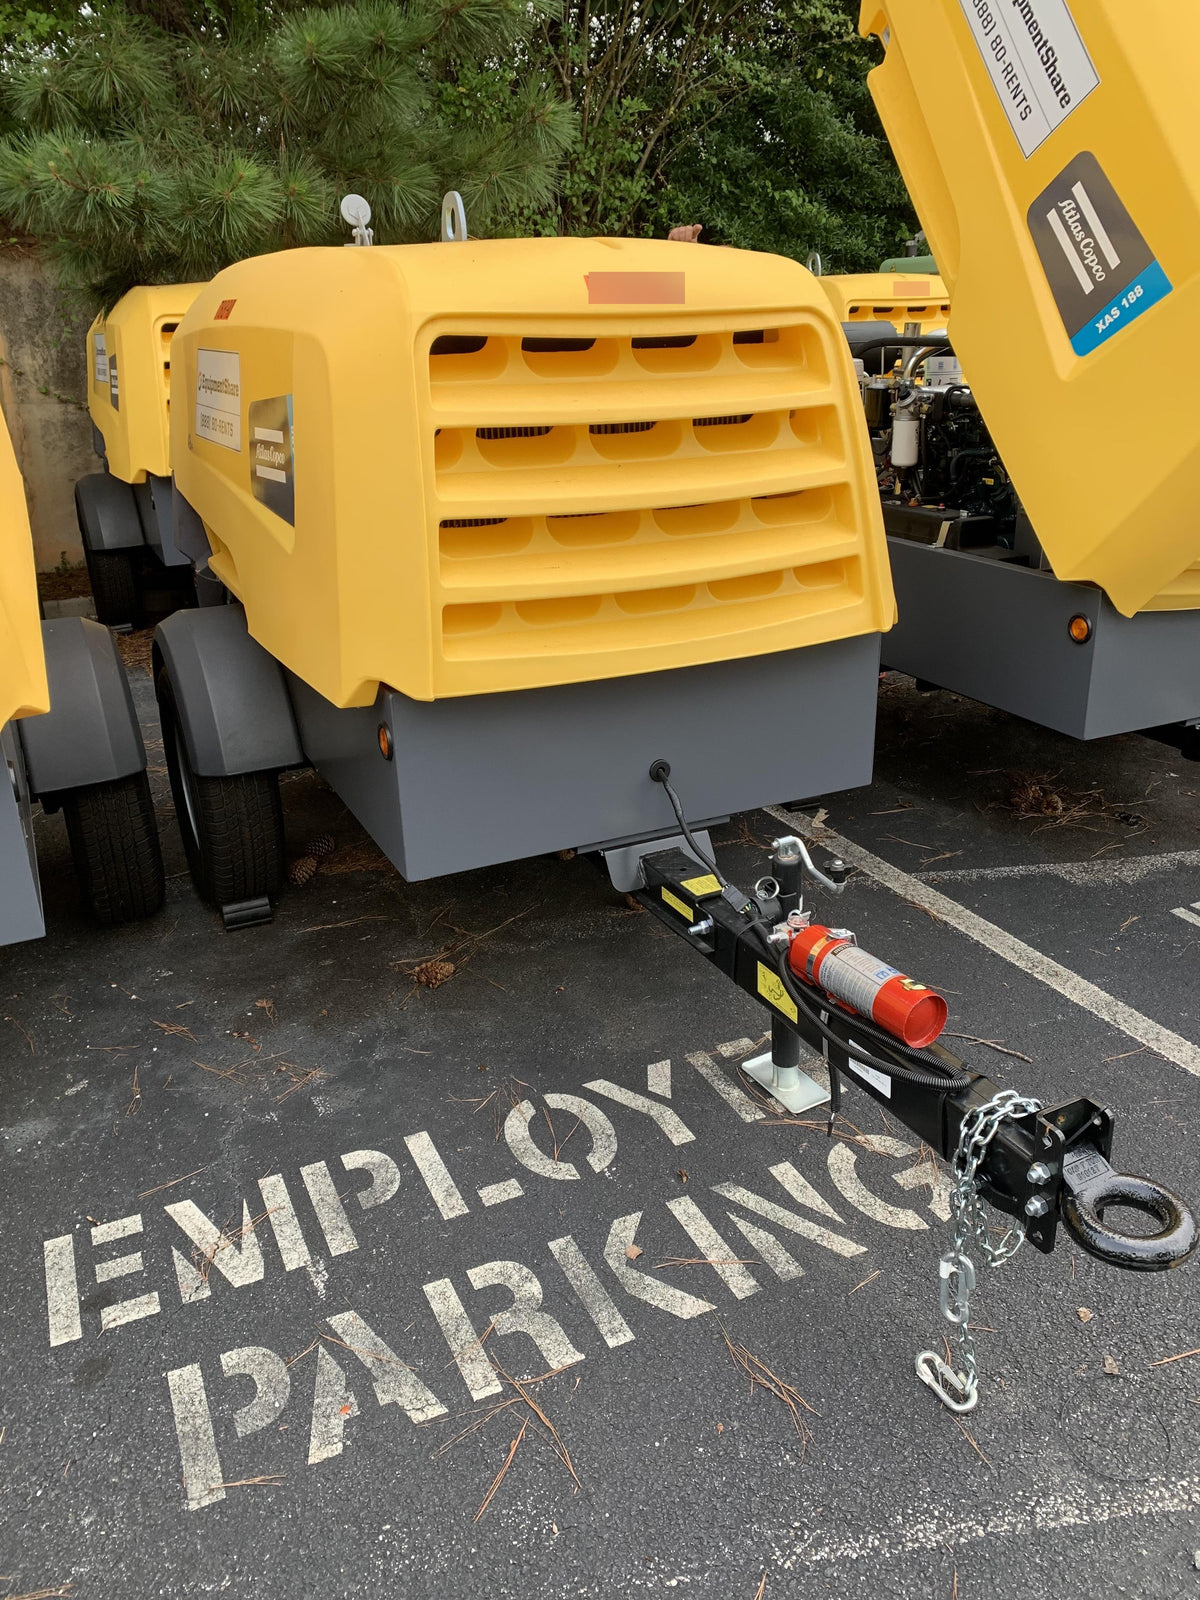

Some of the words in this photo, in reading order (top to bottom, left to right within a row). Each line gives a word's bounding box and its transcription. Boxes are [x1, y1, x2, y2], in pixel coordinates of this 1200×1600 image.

[990, 34, 1032, 121] 80-RENTS
[1058, 199, 1086, 241] Atlas
[1080, 237, 1106, 282] Copco
[1095, 306, 1120, 333] XAS
[1121, 285, 1144, 308] 188
[202, 373, 239, 397] EquipmentShare
[166, 1134, 958, 1512] PARKING
